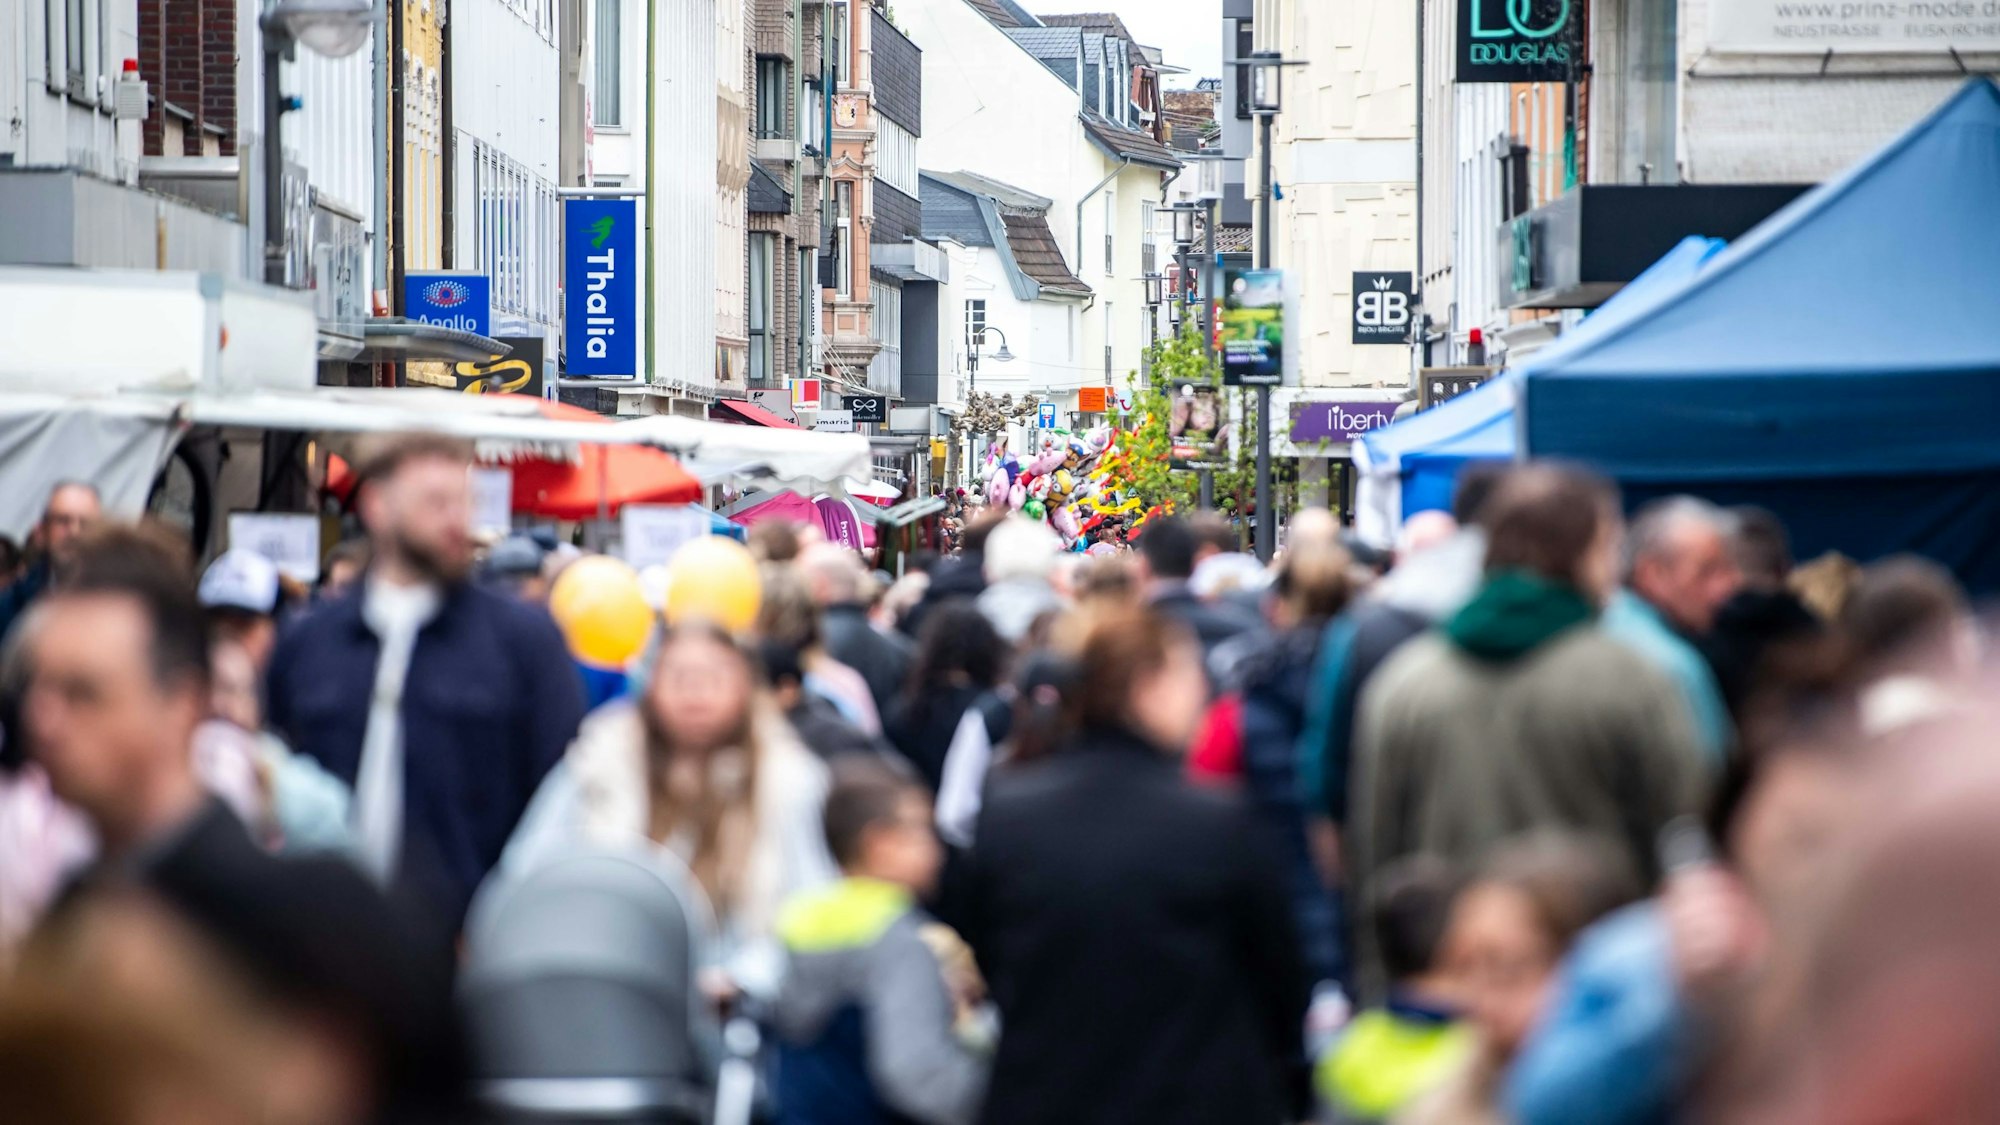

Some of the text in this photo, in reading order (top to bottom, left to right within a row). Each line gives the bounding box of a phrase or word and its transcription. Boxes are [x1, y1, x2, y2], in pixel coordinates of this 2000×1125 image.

[1774, 0, 2000, 19] www.prinz-mode.d
[1903, 22, 2000, 39] EUSKIRCHE
[1470, 42, 1570, 64] DOUGLAS
[586, 248, 615, 359] Thalia
[1328, 405, 1396, 431] liberty
